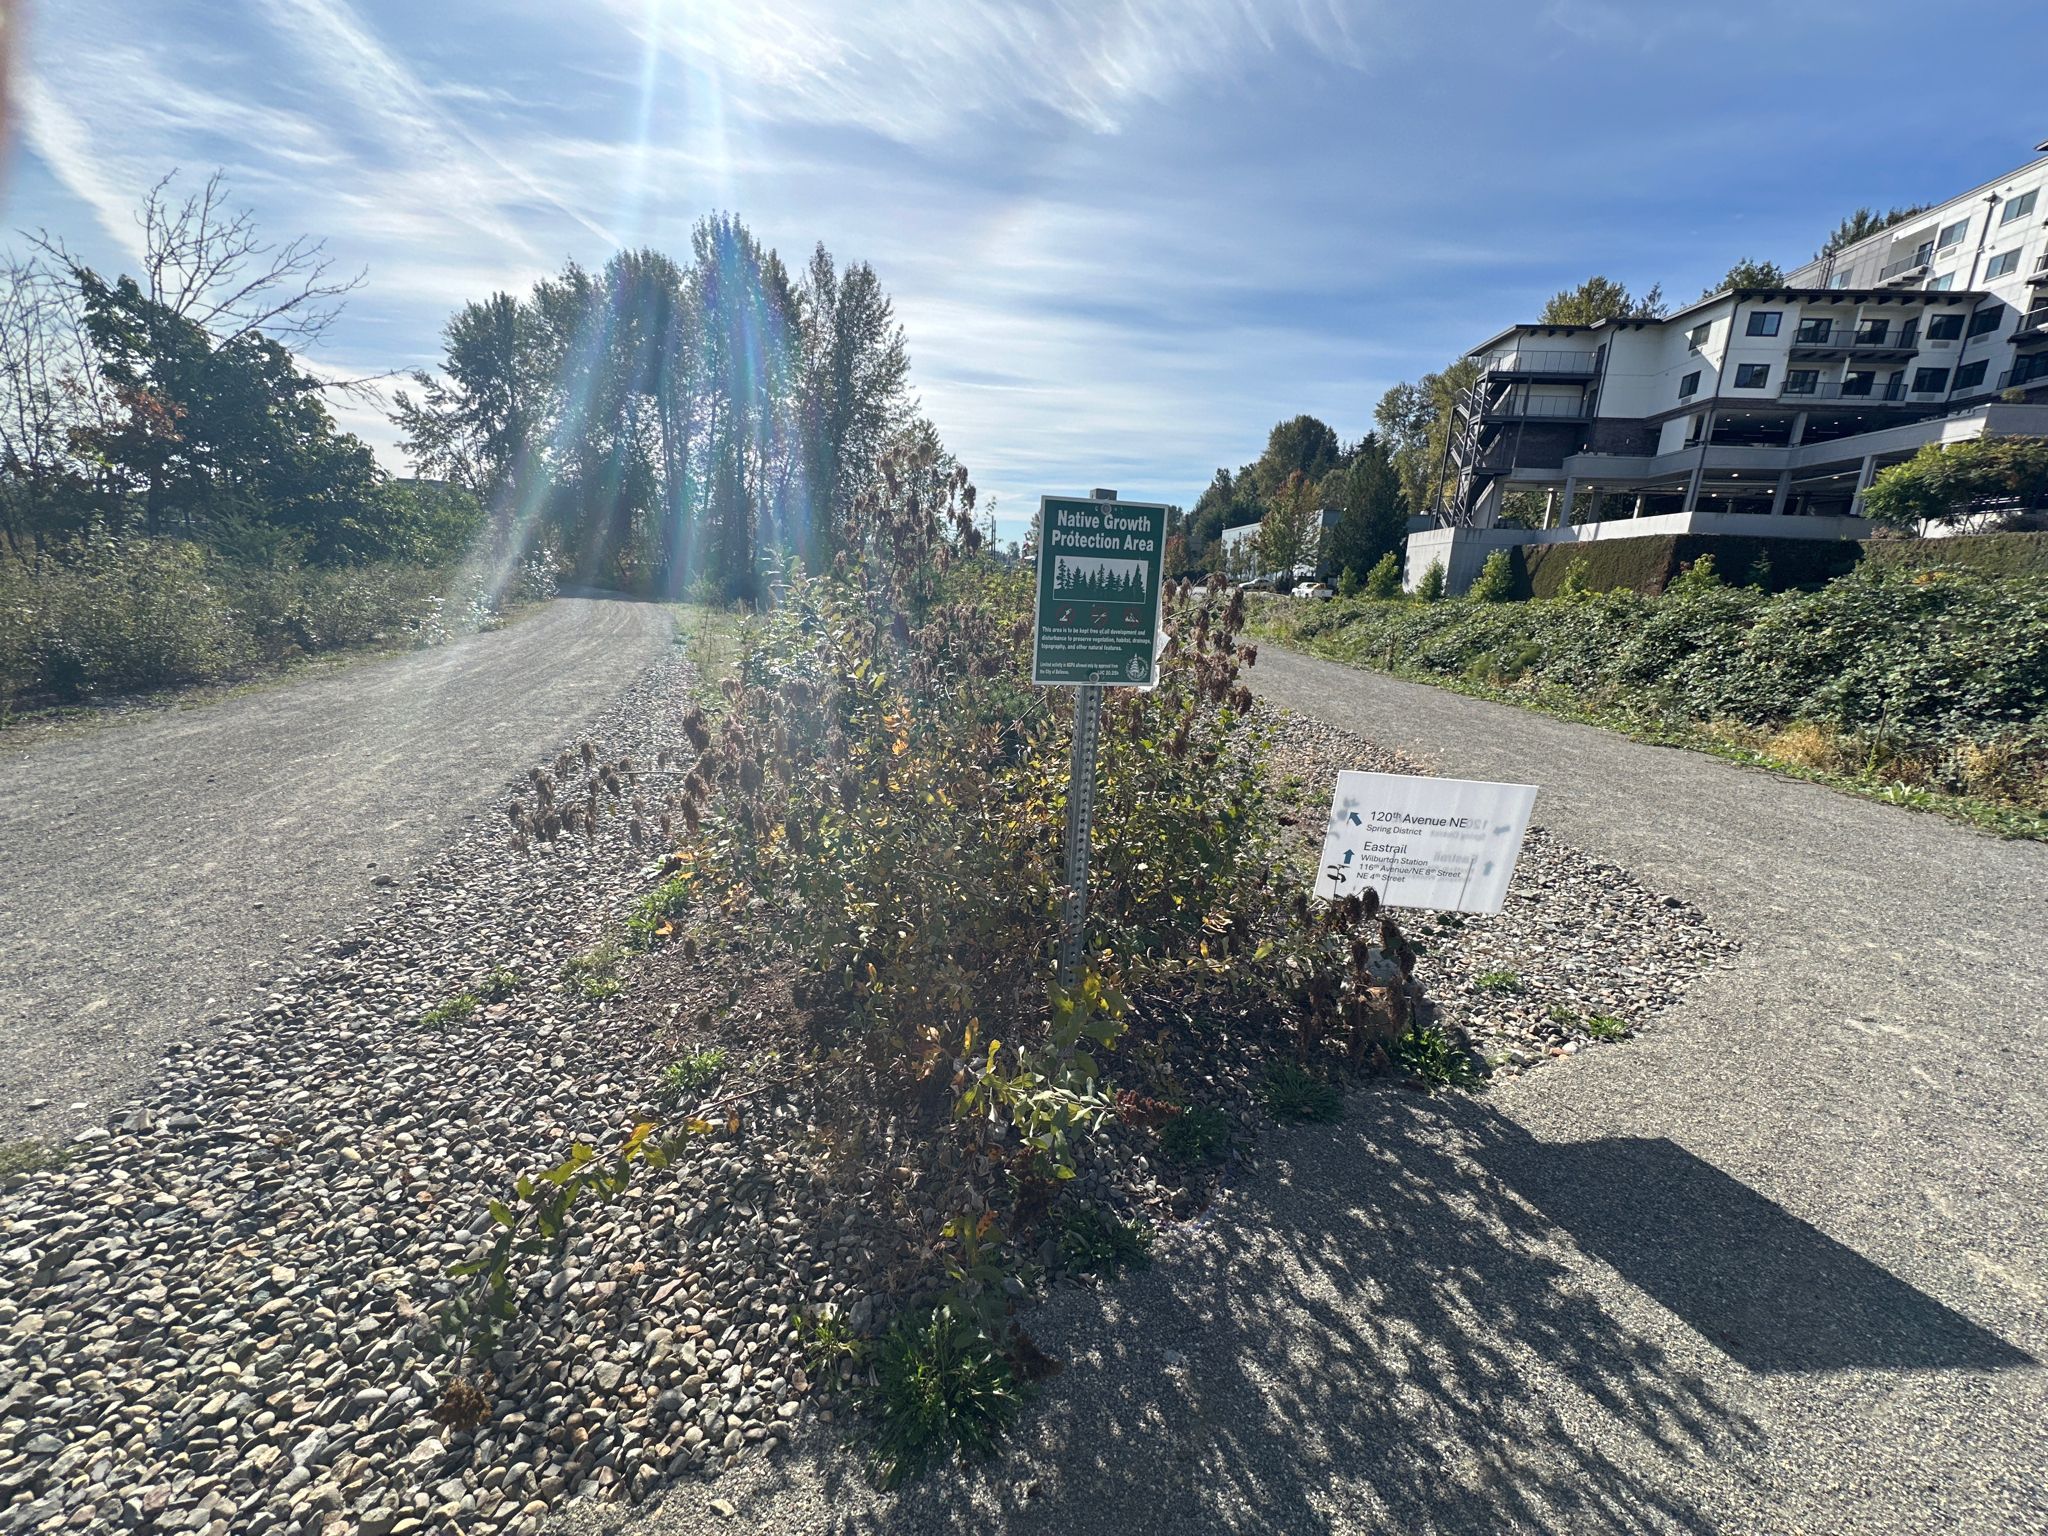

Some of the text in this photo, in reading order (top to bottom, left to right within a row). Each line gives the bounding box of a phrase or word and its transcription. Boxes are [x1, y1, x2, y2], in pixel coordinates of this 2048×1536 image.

[1058, 510, 1150, 531] Native Growth
[1052, 530, 1153, 552] Protection Area
[1402, 814, 1446, 826] Avenue
[1449, 817, 1468, 828] NE
[1366, 824, 1422, 835] Spring District
[1364, 841, 1407, 854] Eastrail
[1361, 854, 1399, 864] Wilburton
[1380, 865, 1424, 875] Avenue/NE
[1381, 874, 1405, 882] Street
